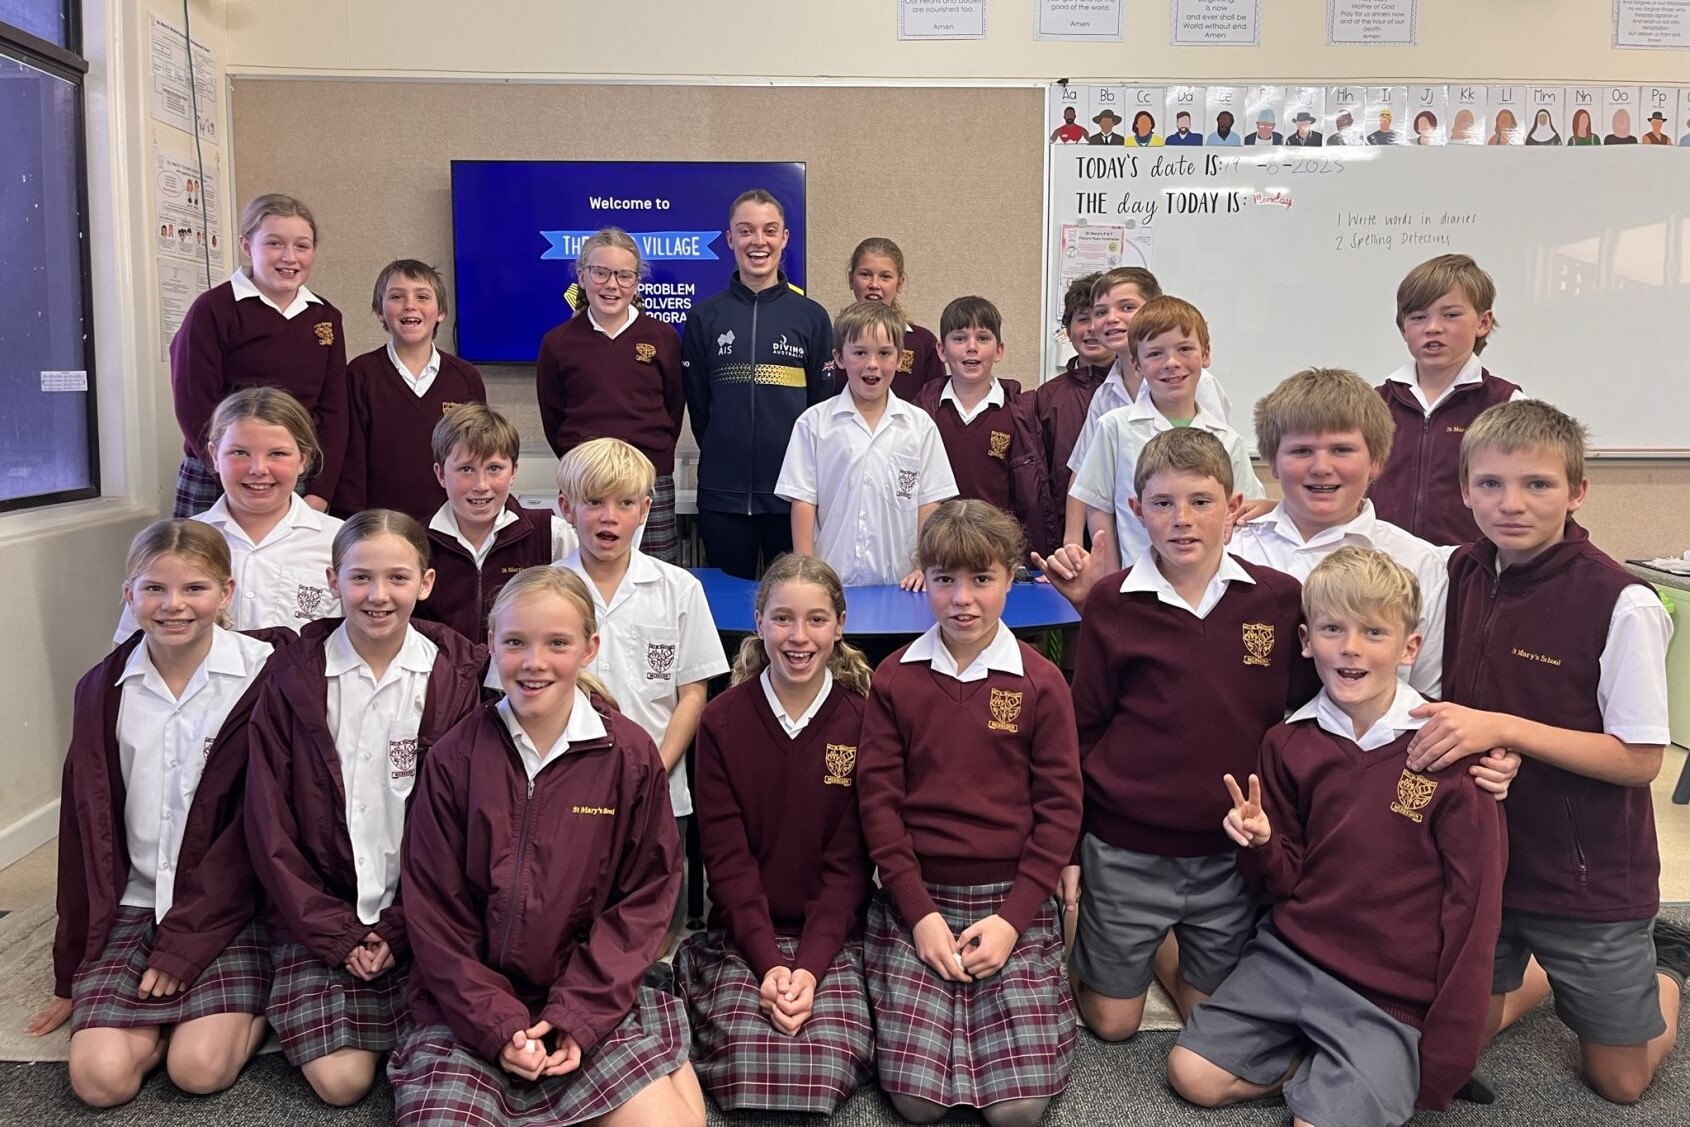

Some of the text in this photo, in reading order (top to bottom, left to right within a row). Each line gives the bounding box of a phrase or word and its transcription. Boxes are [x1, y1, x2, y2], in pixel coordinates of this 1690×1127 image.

[1062, 88, 1077, 100] Aa
[1100, 88, 1115, 102] Bb
[1137, 90, 1151, 103] Cc
[1337, 87, 1354, 102] Hh
[1421, 88, 1434, 105] Jj
[1460, 87, 1475, 100] Kk
[1501, 88, 1512, 101] Ll
[1534, 89, 1556, 102] Mm
[1575, 90, 1593, 102] Nn
[1612, 89, 1629, 101] Oo
[1651, 89, 1667, 106] Pp
[1076, 154, 1223, 179] TODAY'S date IS:
[589, 196, 670, 210] Welcome to
[1253, 191, 1293, 209] Monday
[1076, 191, 1247, 225] THE day TODAY IS:
[1348, 212, 1377, 226] Write
[1385, 212, 1412, 226] words
[1421, 212, 1431, 225] in
[1440, 211, 1477, 225] diaries
[643, 236, 700, 256] VILLAGE
[1335, 232, 1450, 250] 2 Spelling Detectives
[637, 283, 695, 295] PROBLEM
[642, 297, 692, 309] OLVERS
[718, 346, 732, 356] AIS
[1517, 649, 1540, 660] Mary's
[1540, 655, 1561, 666] School
